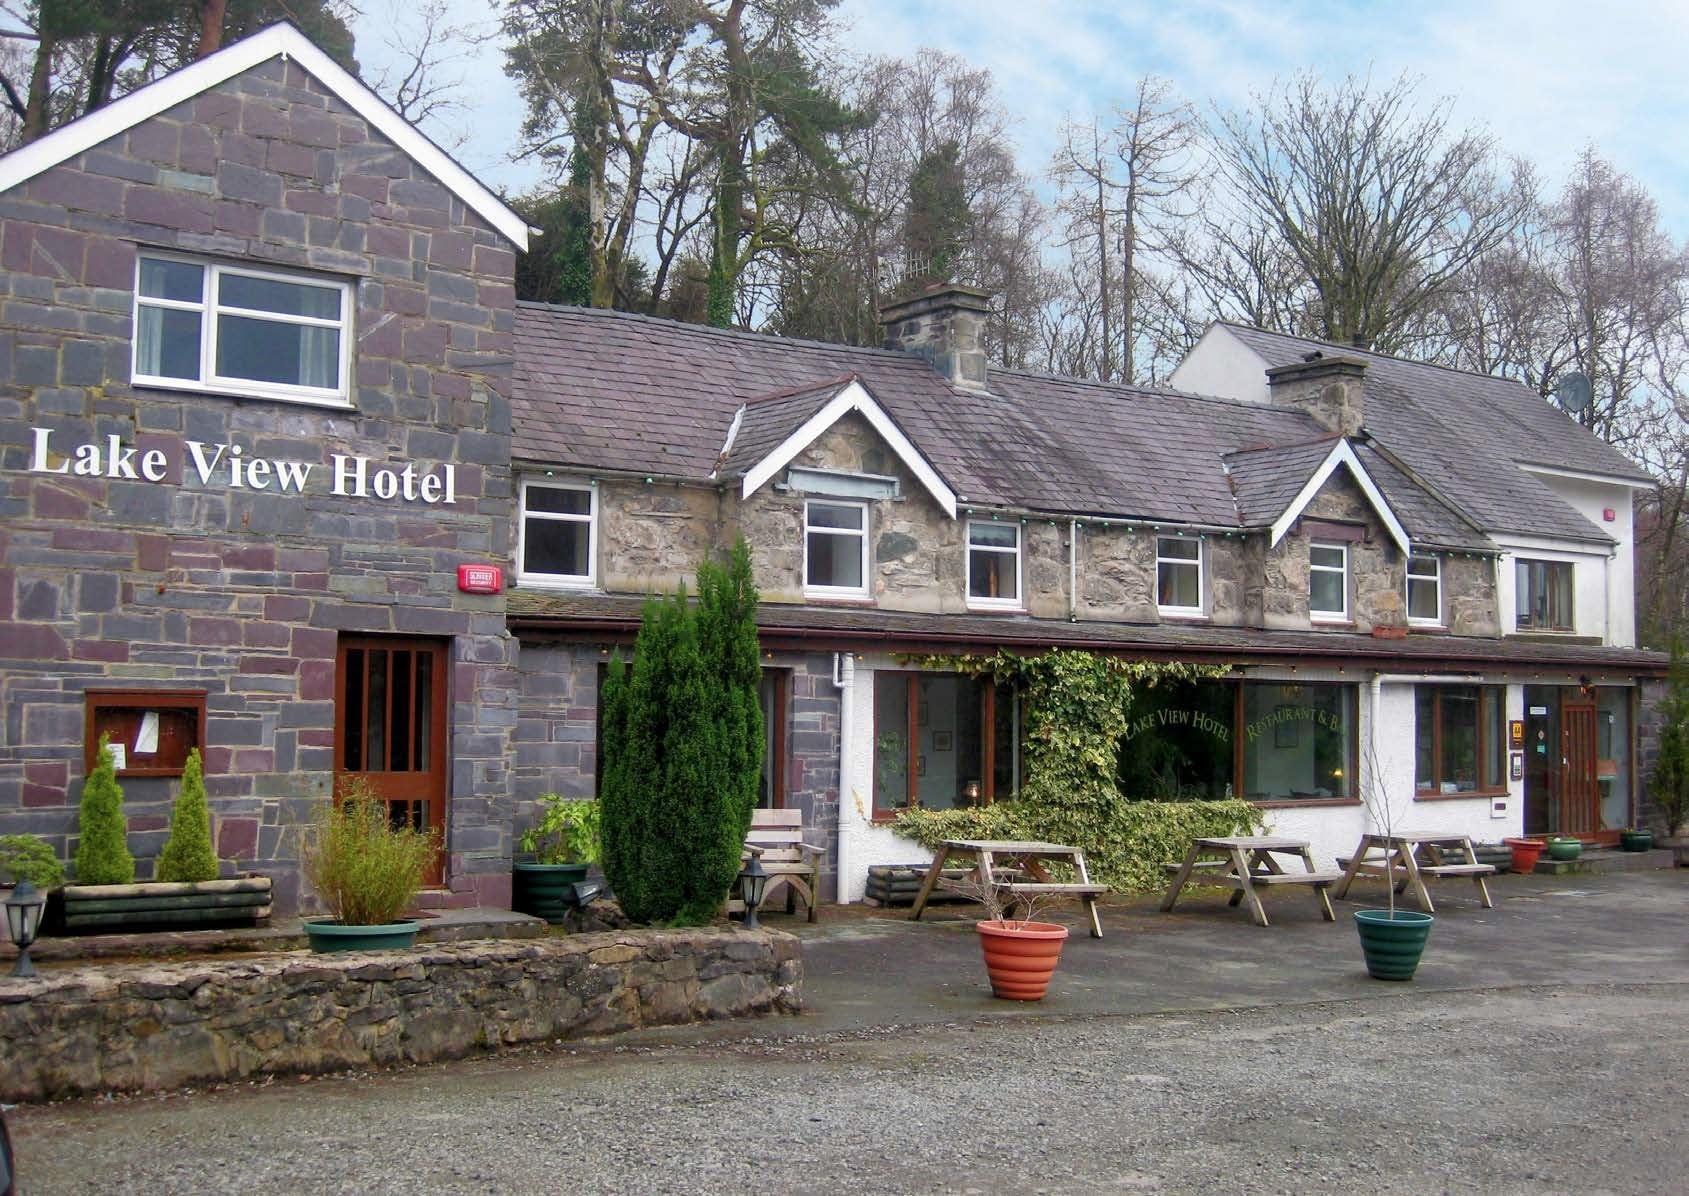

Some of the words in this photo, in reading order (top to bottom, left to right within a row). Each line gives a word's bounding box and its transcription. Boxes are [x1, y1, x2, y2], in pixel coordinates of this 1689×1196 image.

[29, 427, 168, 482] Lake
[185, 440, 313, 492] View
[329, 453, 457, 504] Hotel
[1157, 708, 1190, 726] VIEW
[1192, 710, 1229, 742] HOTEL
[1247, 707, 1317, 743] RESTAURANT
